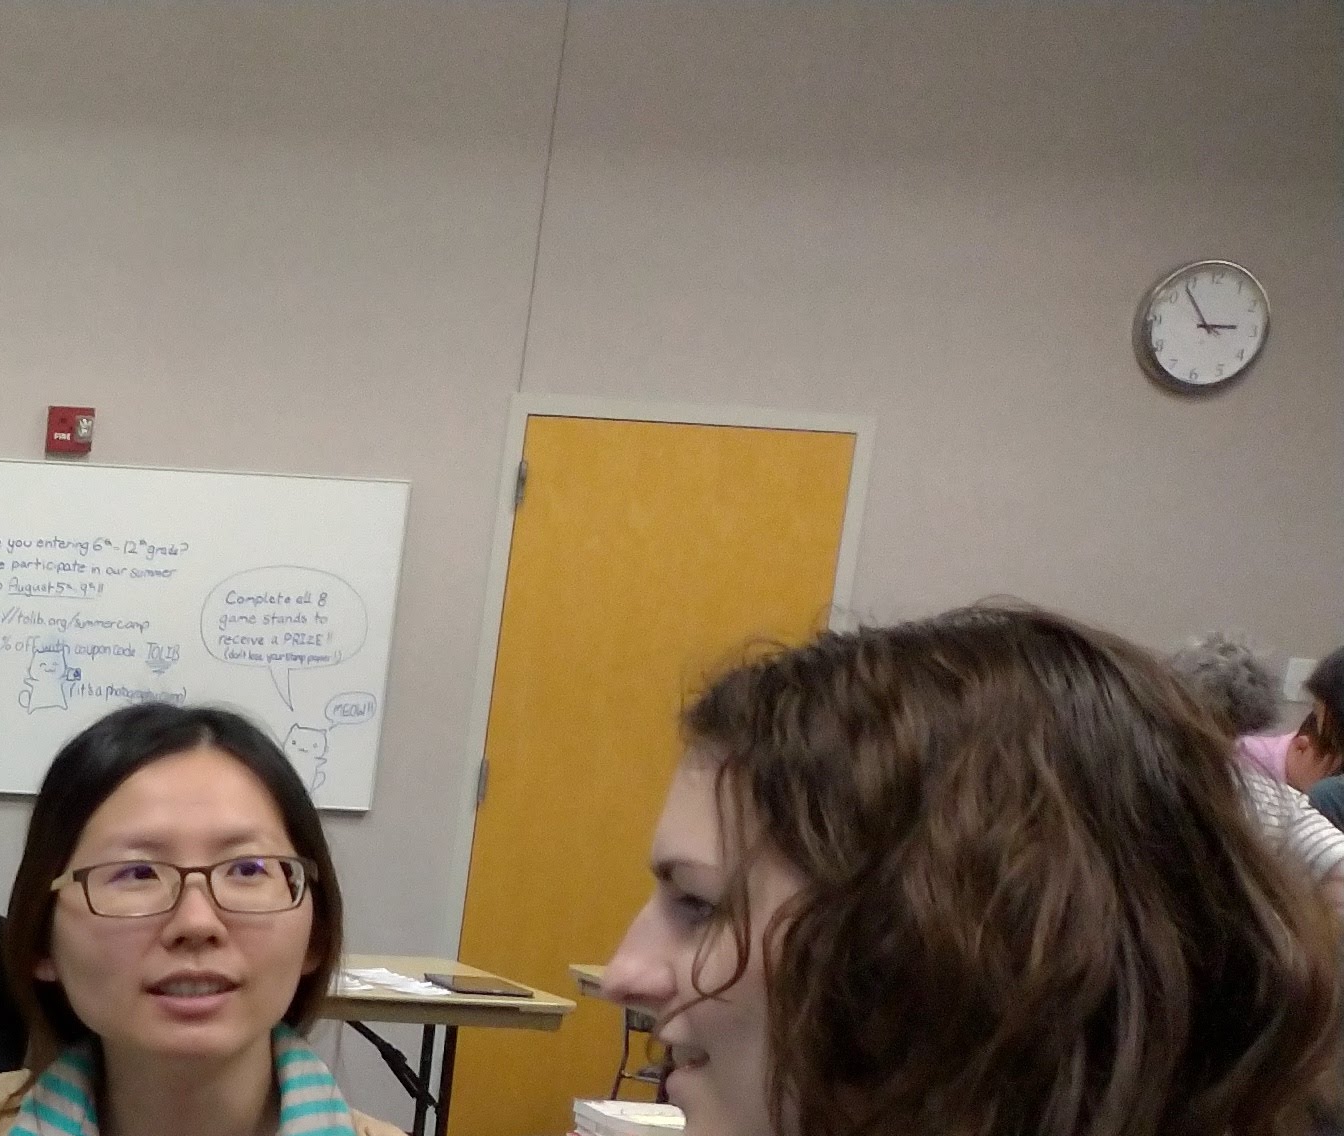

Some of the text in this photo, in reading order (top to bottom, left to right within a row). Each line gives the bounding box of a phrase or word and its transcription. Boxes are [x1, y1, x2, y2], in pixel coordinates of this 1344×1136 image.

[8, 537, 32, 554] you
[36, 535, 89, 557] entering
[11, 559, 87, 575] participate
[91, 564, 101, 575] in
[106, 566, 127, 576] our
[130, 567, 177, 579] summer
[9, 575, 54, 595] August
[225, 589, 291, 608] Complete
[317, 591, 328, 607] 8
[218, 611, 328, 631] game stands to
[218, 634, 265, 646] receive
[271, 636, 279, 645] a
